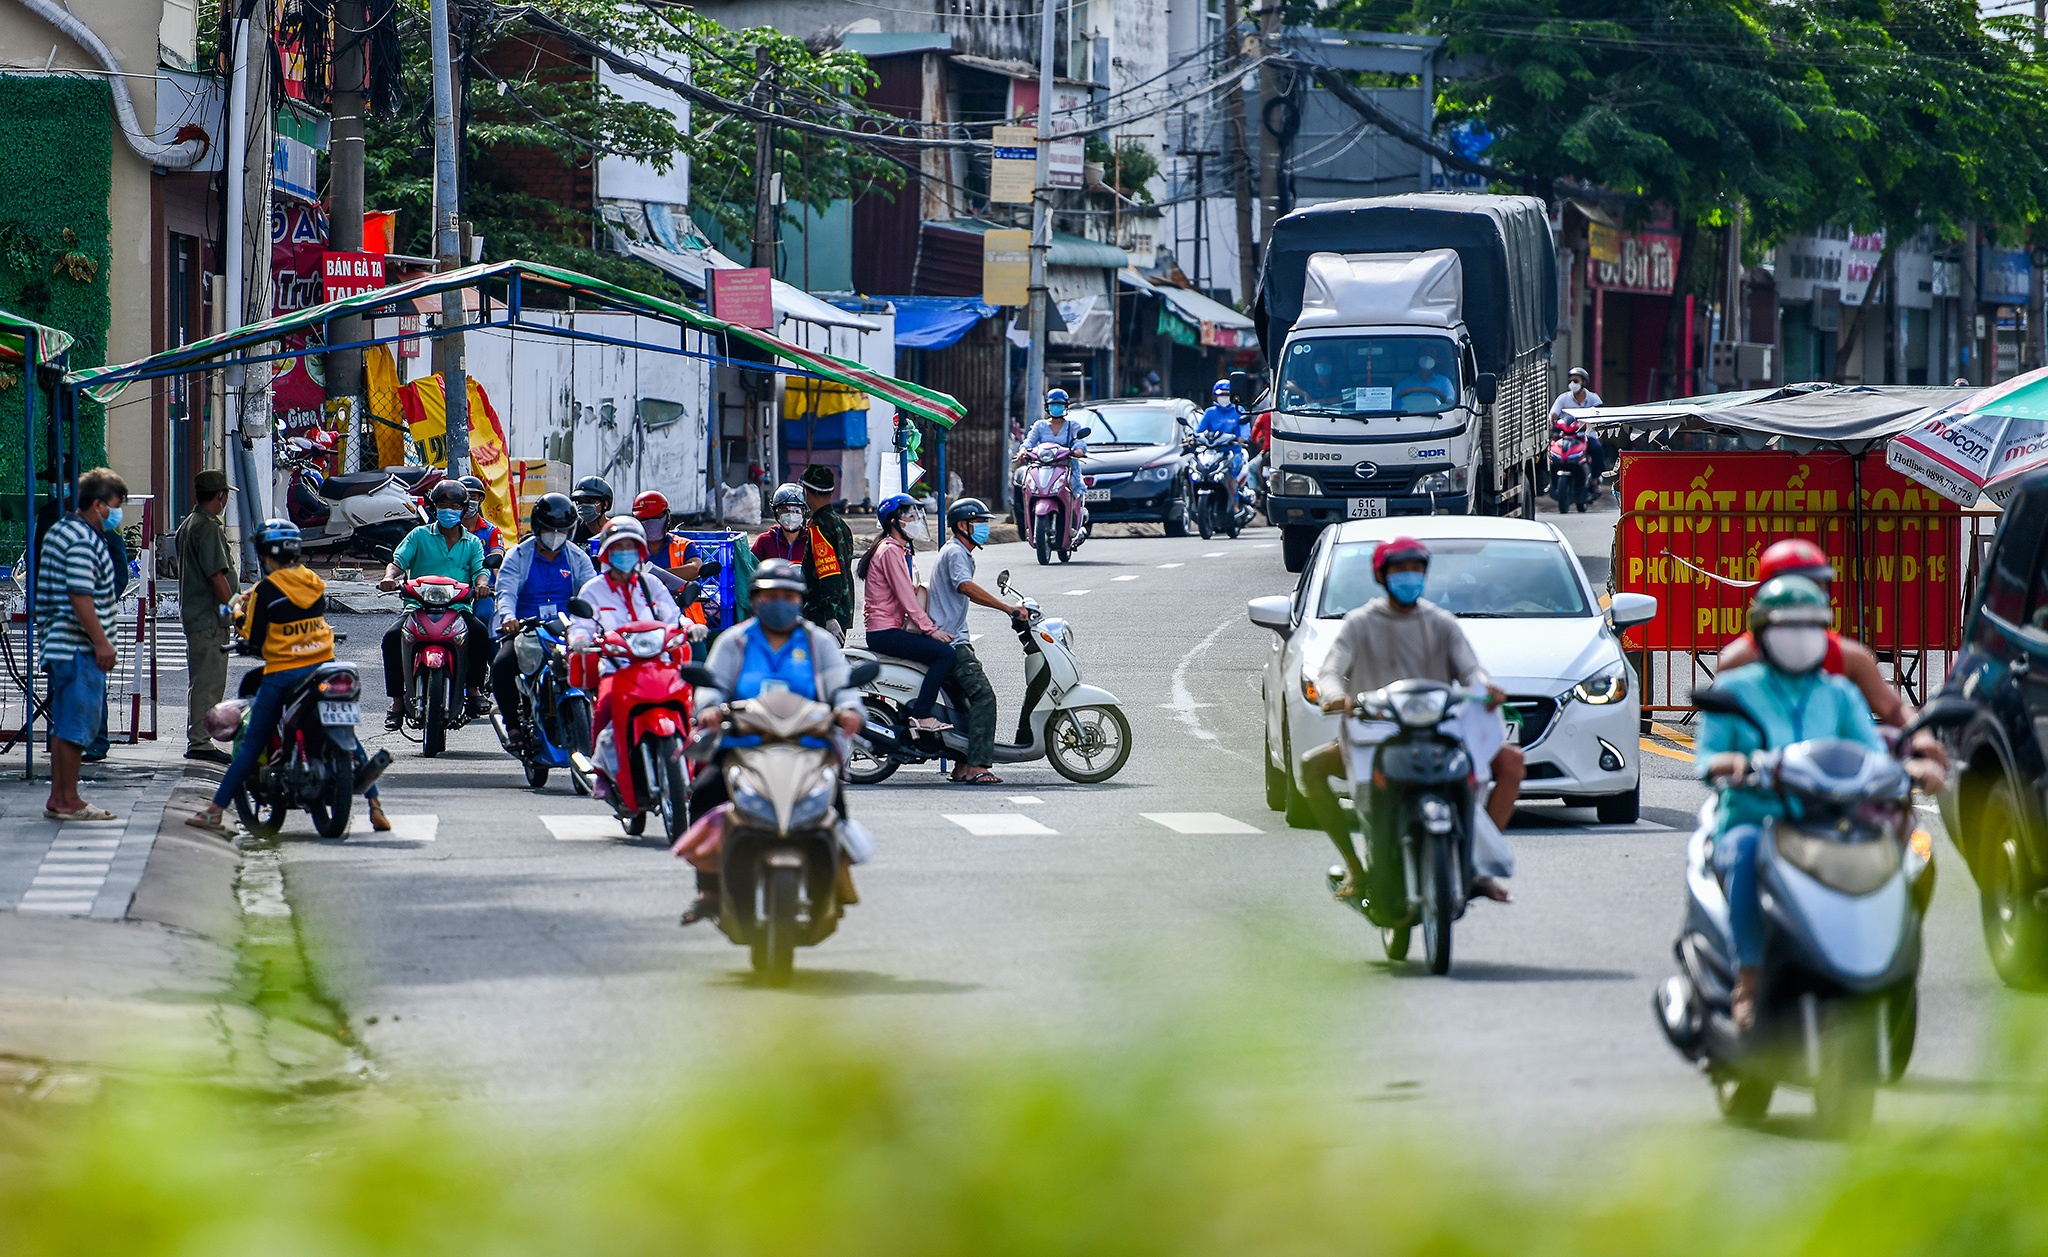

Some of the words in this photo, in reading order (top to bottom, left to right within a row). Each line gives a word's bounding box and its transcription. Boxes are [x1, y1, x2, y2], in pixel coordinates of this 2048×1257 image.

[326, 256, 352, 277] BÁN
[354, 257, 369, 277] GÀ
[371, 261, 383, 277] TA
[1924, 420, 1989, 461] maicom
[1303, 452, 1342, 460] HINO
[1418, 449, 1446, 457] QDR
[1893, 452, 1926, 474] Hotline:
[1925, 467, 1973, 502] 0898.778.778
[1358, 499, 1376, 508] 61C
[1634, 464, 1737, 534] CHỐT
[1746, 464, 1839, 533] KIỂM
[1847, 476, 1945, 531] SOÁT
[1351, 508, 1382, 517] 473.61
[1629, 546, 1720, 590] PHÒNG,
[1725, 541, 1761, 584] CHỐ
